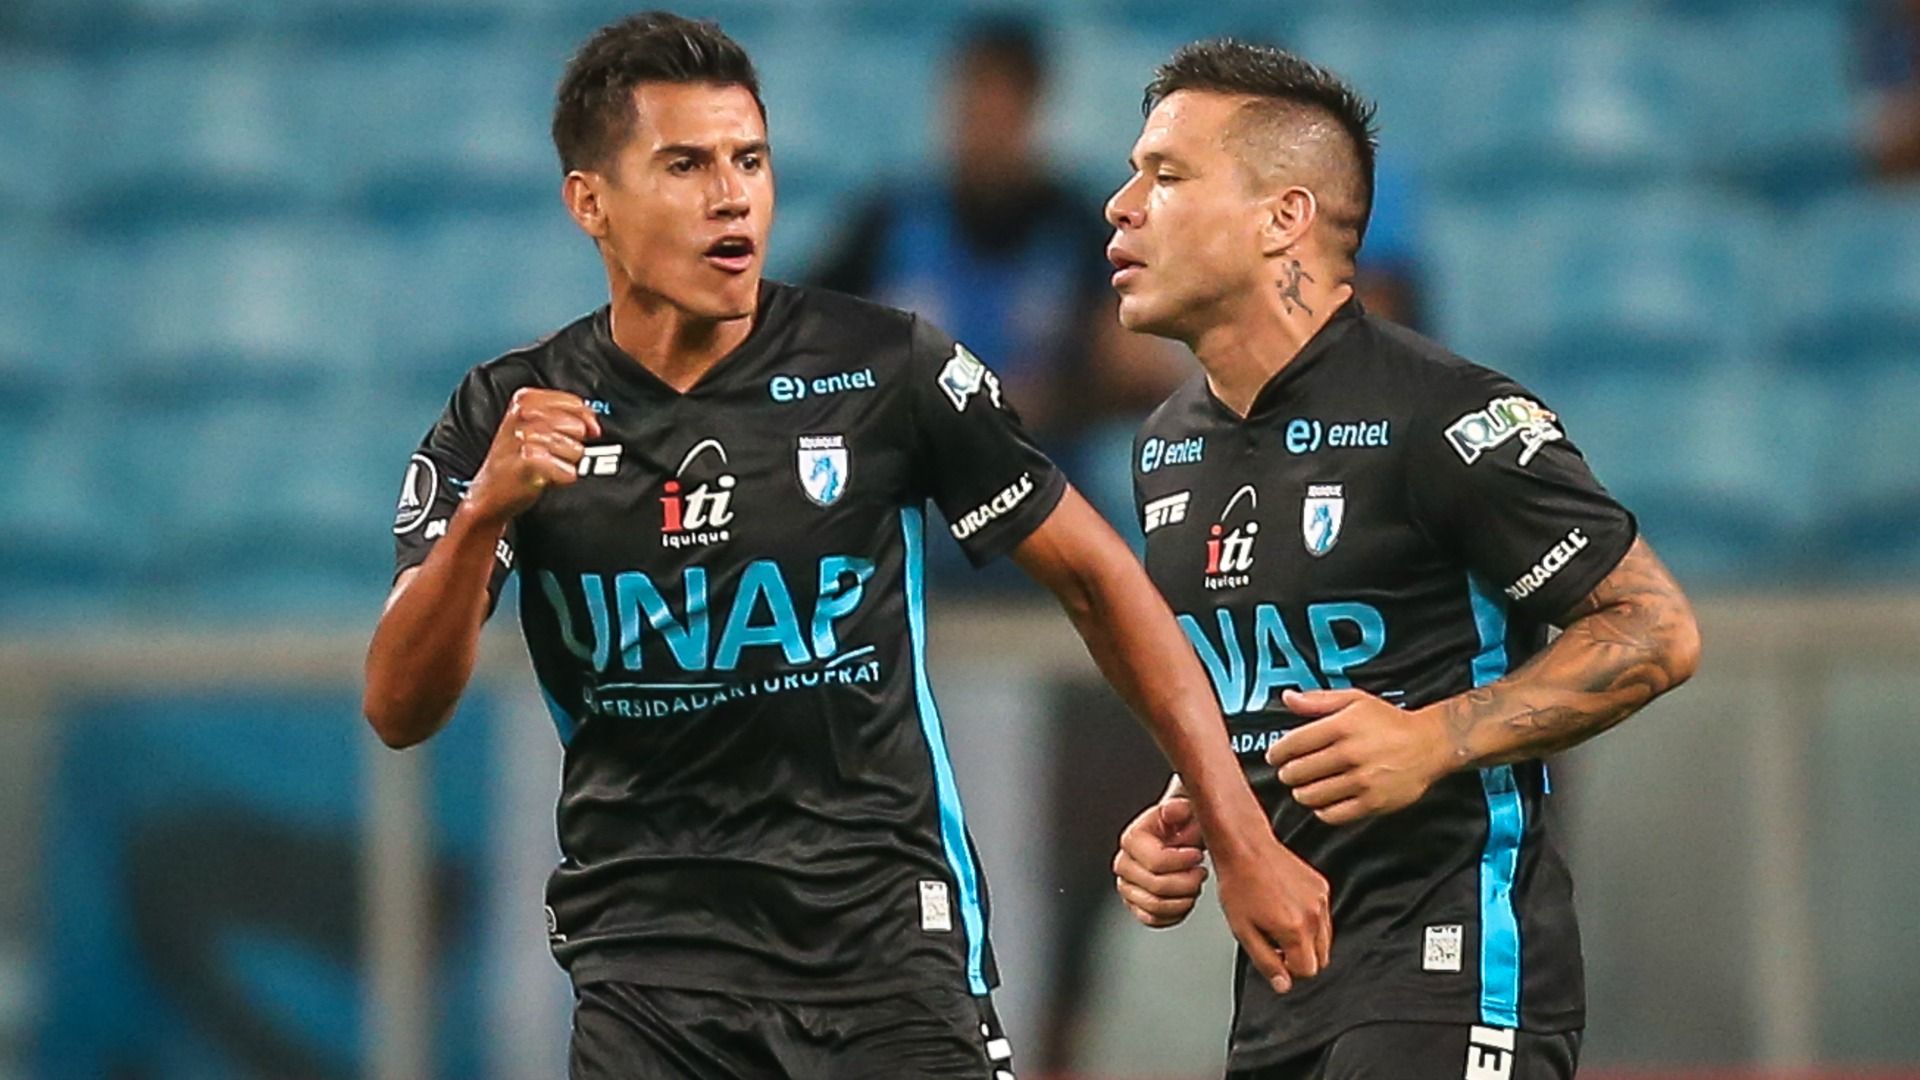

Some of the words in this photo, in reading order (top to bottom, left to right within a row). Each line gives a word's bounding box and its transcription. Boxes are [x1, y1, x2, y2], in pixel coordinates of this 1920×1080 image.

[812, 368, 876, 394] entel
[1164, 436, 1204, 465] entel
[1328, 421, 1389, 446] entel
[659, 475, 736, 532] iti
[951, 472, 1034, 539] URACELL
[1205, 522, 1258, 574] iti
[539, 556, 875, 672] UNAP
[1176, 602, 1386, 715] NAP
